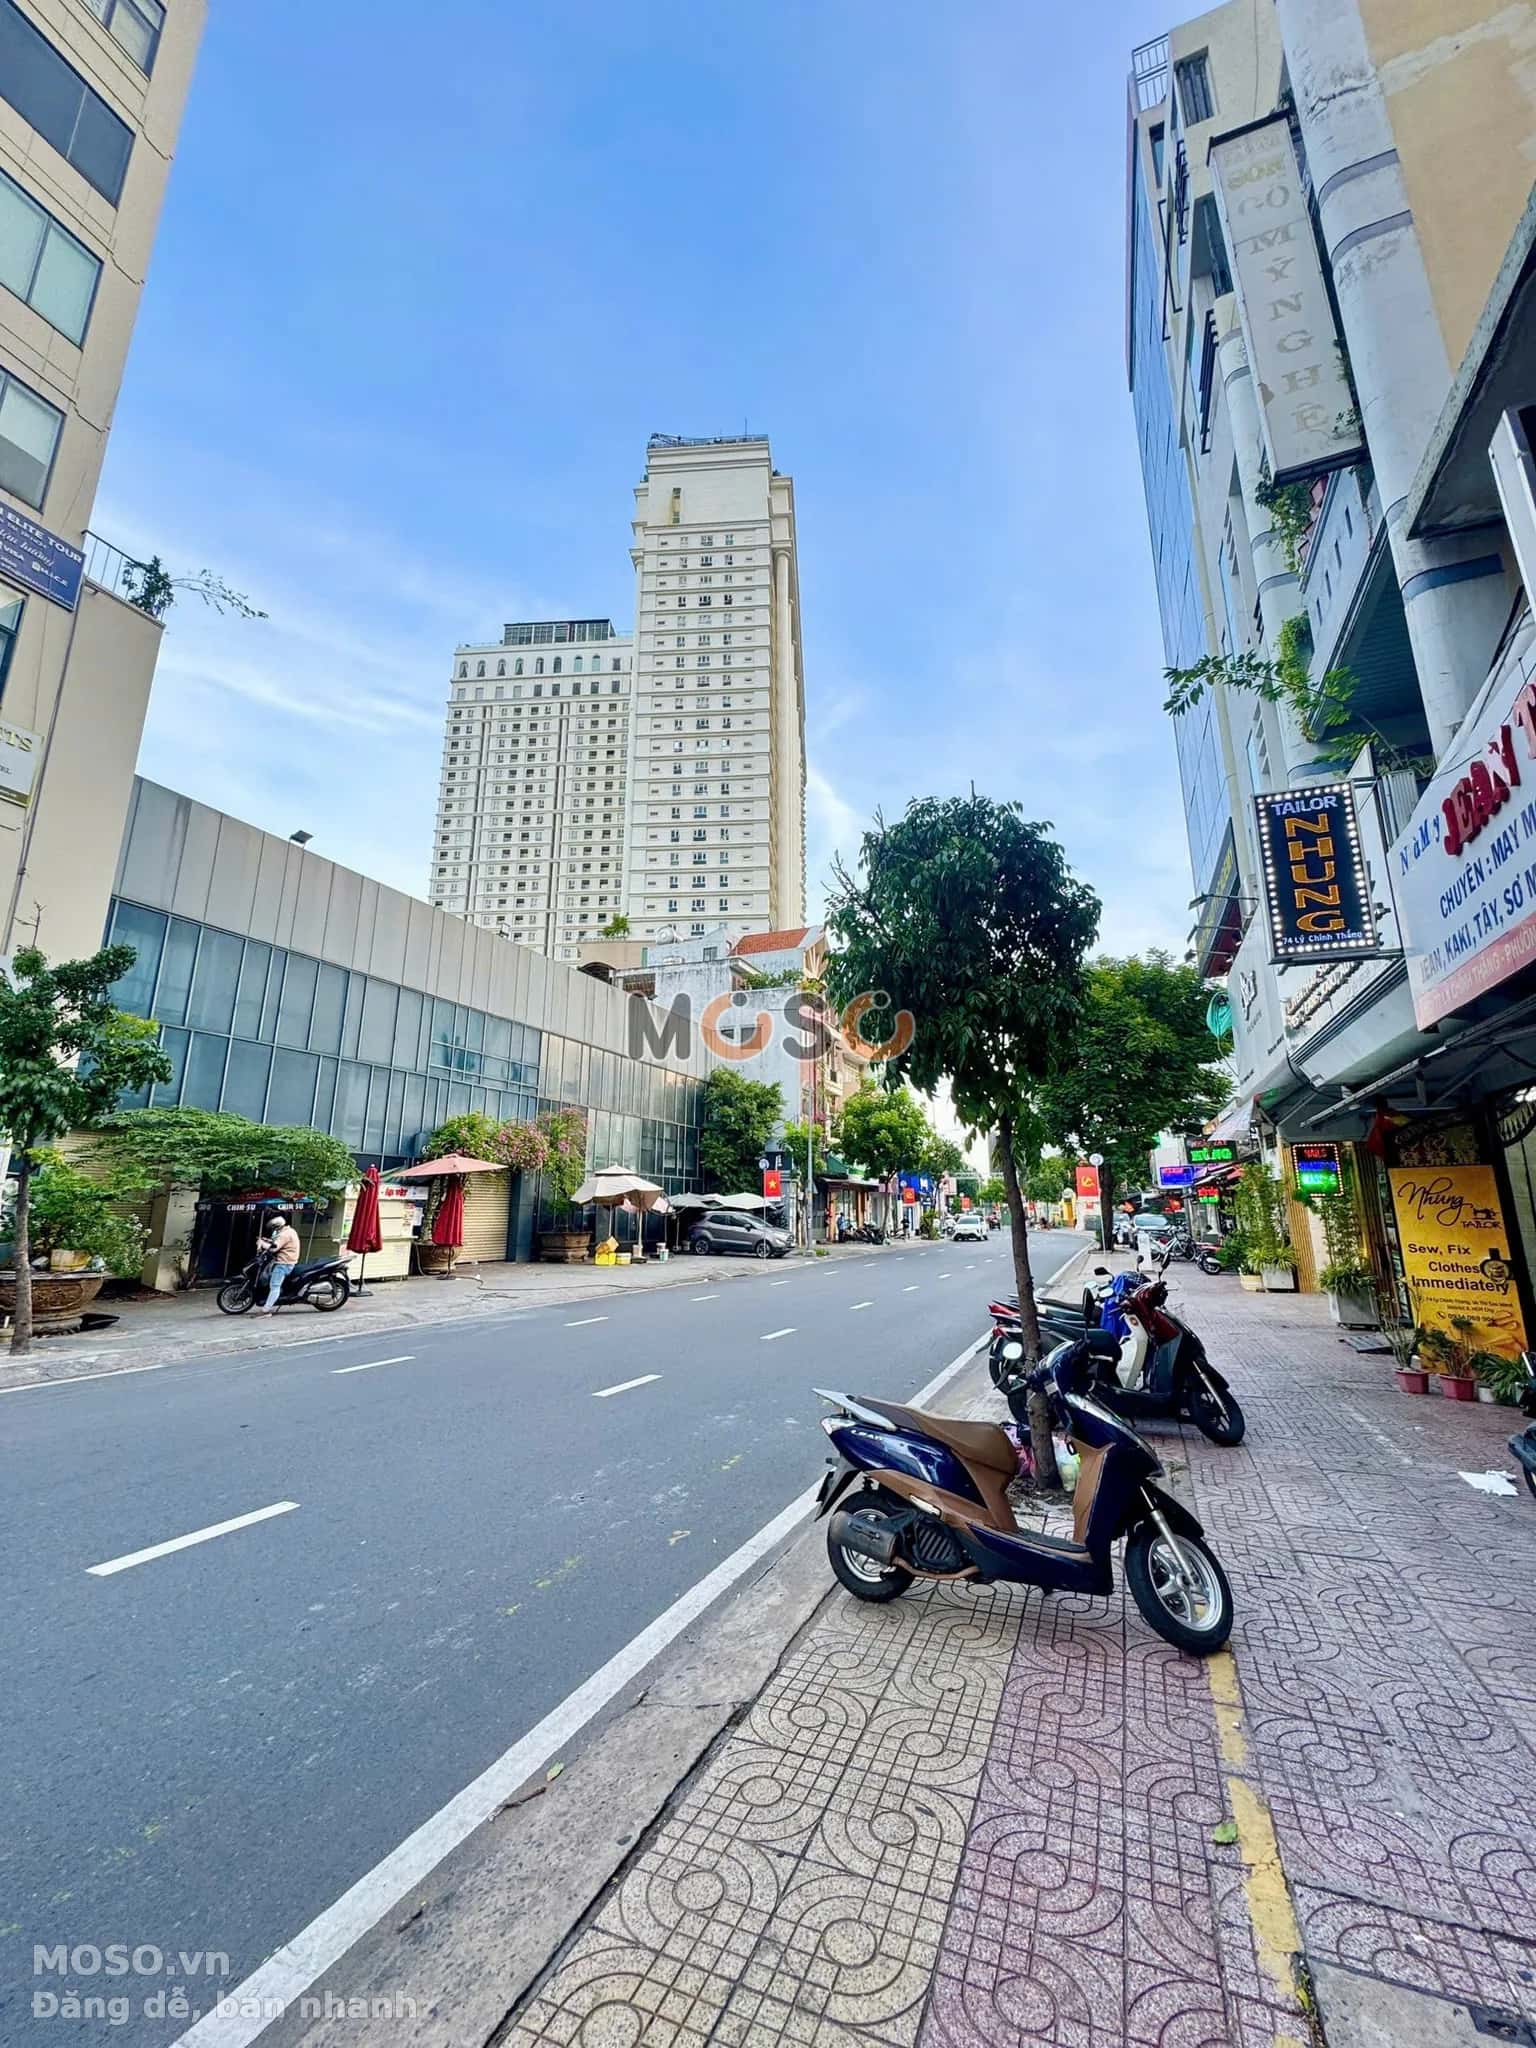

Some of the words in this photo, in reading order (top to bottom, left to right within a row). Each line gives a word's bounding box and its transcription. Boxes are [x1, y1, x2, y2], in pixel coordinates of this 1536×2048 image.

[7, 512, 45, 540] ELITE
[47, 536, 82, 563] TOUR
[1271, 795, 1338, 816] TAILOR
[1284, 813, 1345, 932] NHUNG
[1440, 857, 1485, 919] CHUYÊN
[1490, 820, 1521, 871] MAY
[1282, 937, 1293, 945] 74
[1308, 932, 1333, 942] Chính
[1336, 929, 1362, 940] Thắng
[1444, 923, 1477, 962] KAKI,
[1473, 898, 1504, 938] TÂY,
[1397, 1176, 1474, 1227] Nhung
[1461, 1220, 1502, 1229] TAILOR
[1408, 1243, 1443, 1256] Sew,
[1448, 1244, 1471, 1255] Fix
[1428, 1261, 1480, 1274] Clothes
